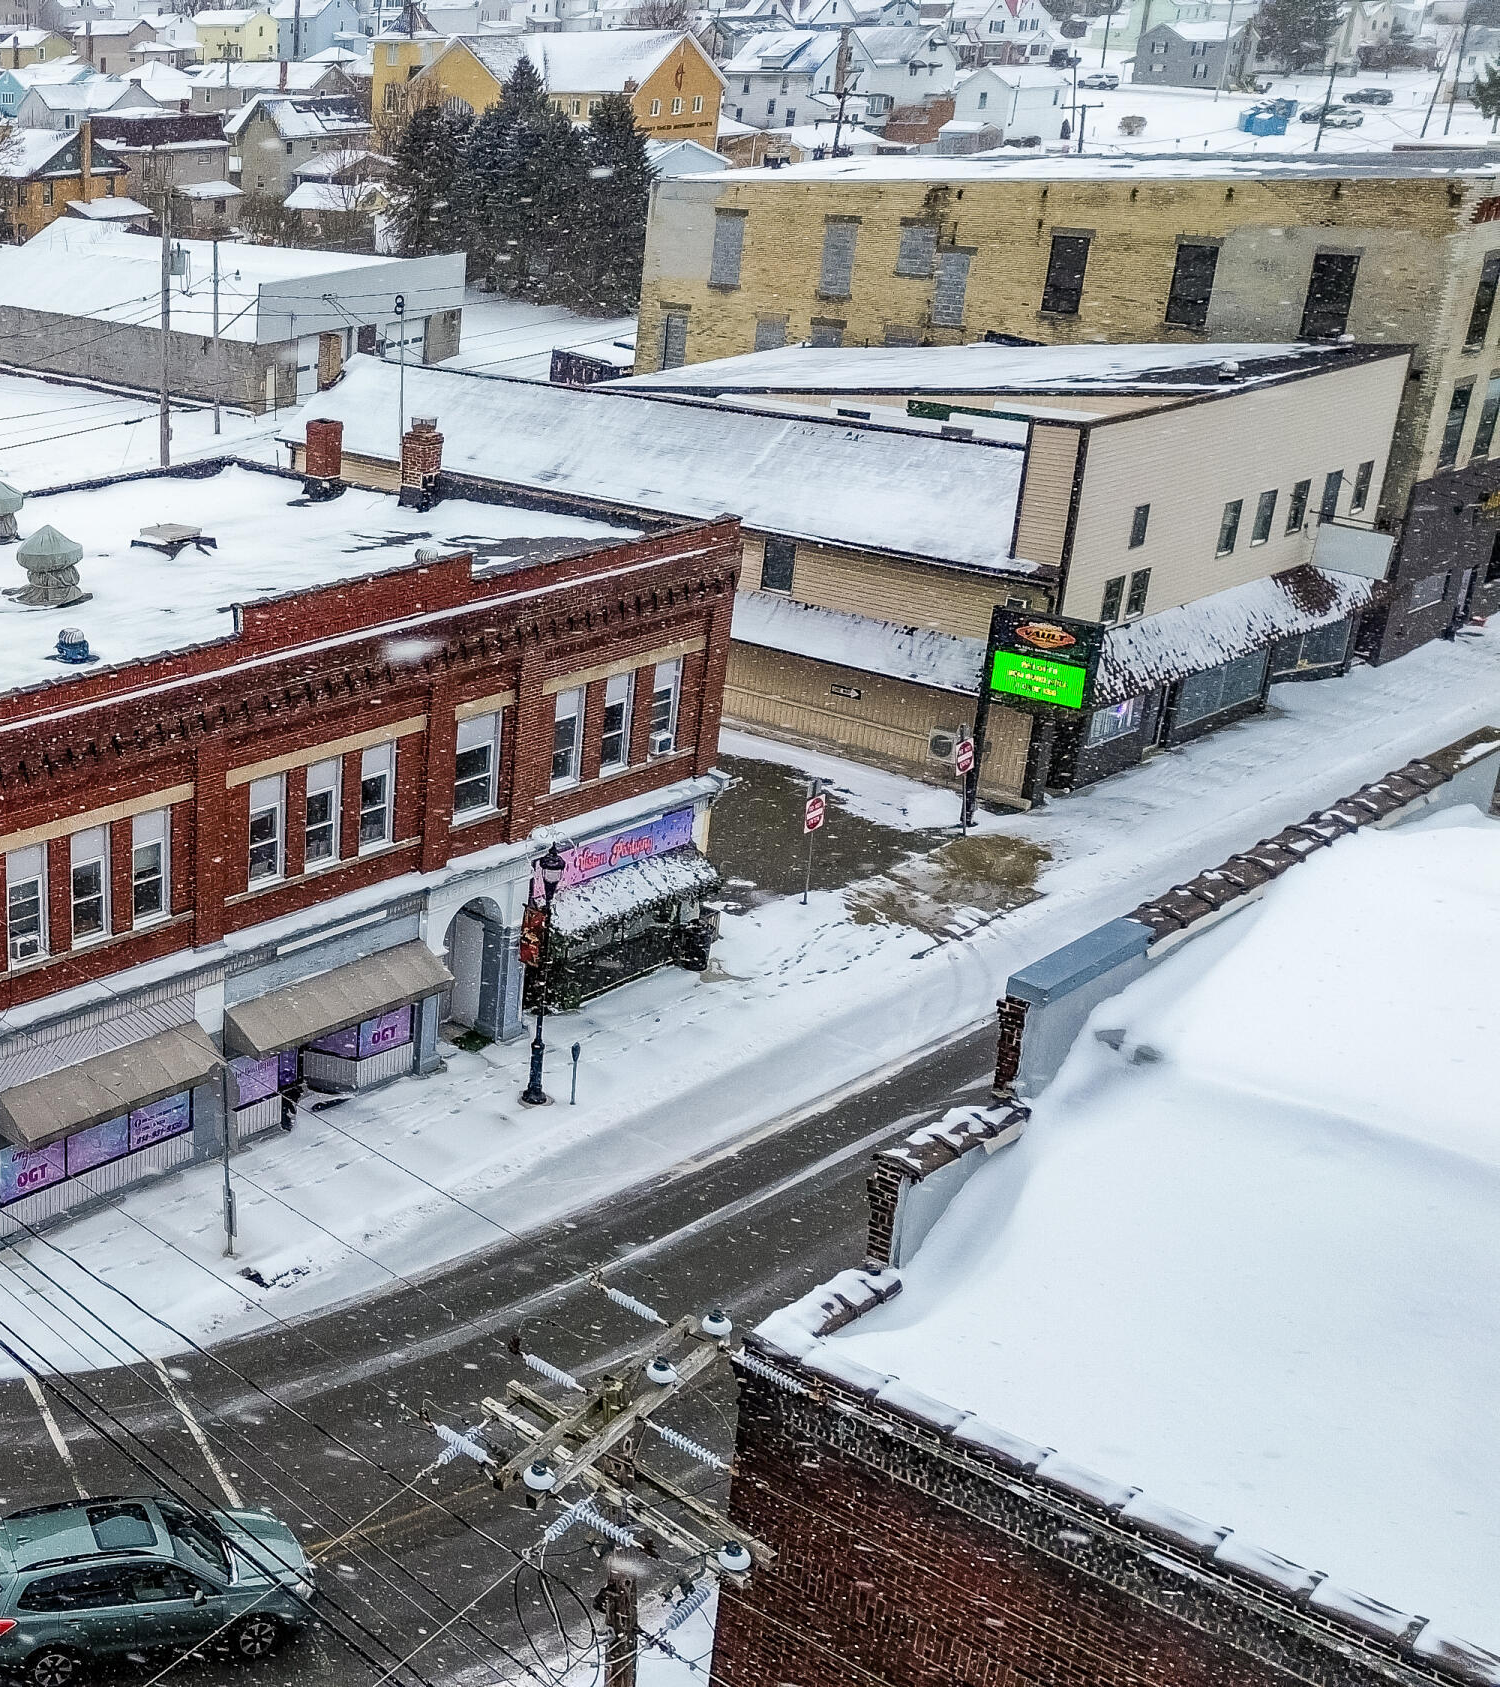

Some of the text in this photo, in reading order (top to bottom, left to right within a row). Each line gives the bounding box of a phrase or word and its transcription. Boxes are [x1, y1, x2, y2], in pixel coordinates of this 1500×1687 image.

[1024, 628, 1068, 642] VAULT
[371, 1024, 398, 1045] OGT
[17, 1162, 48, 1188] OGT
